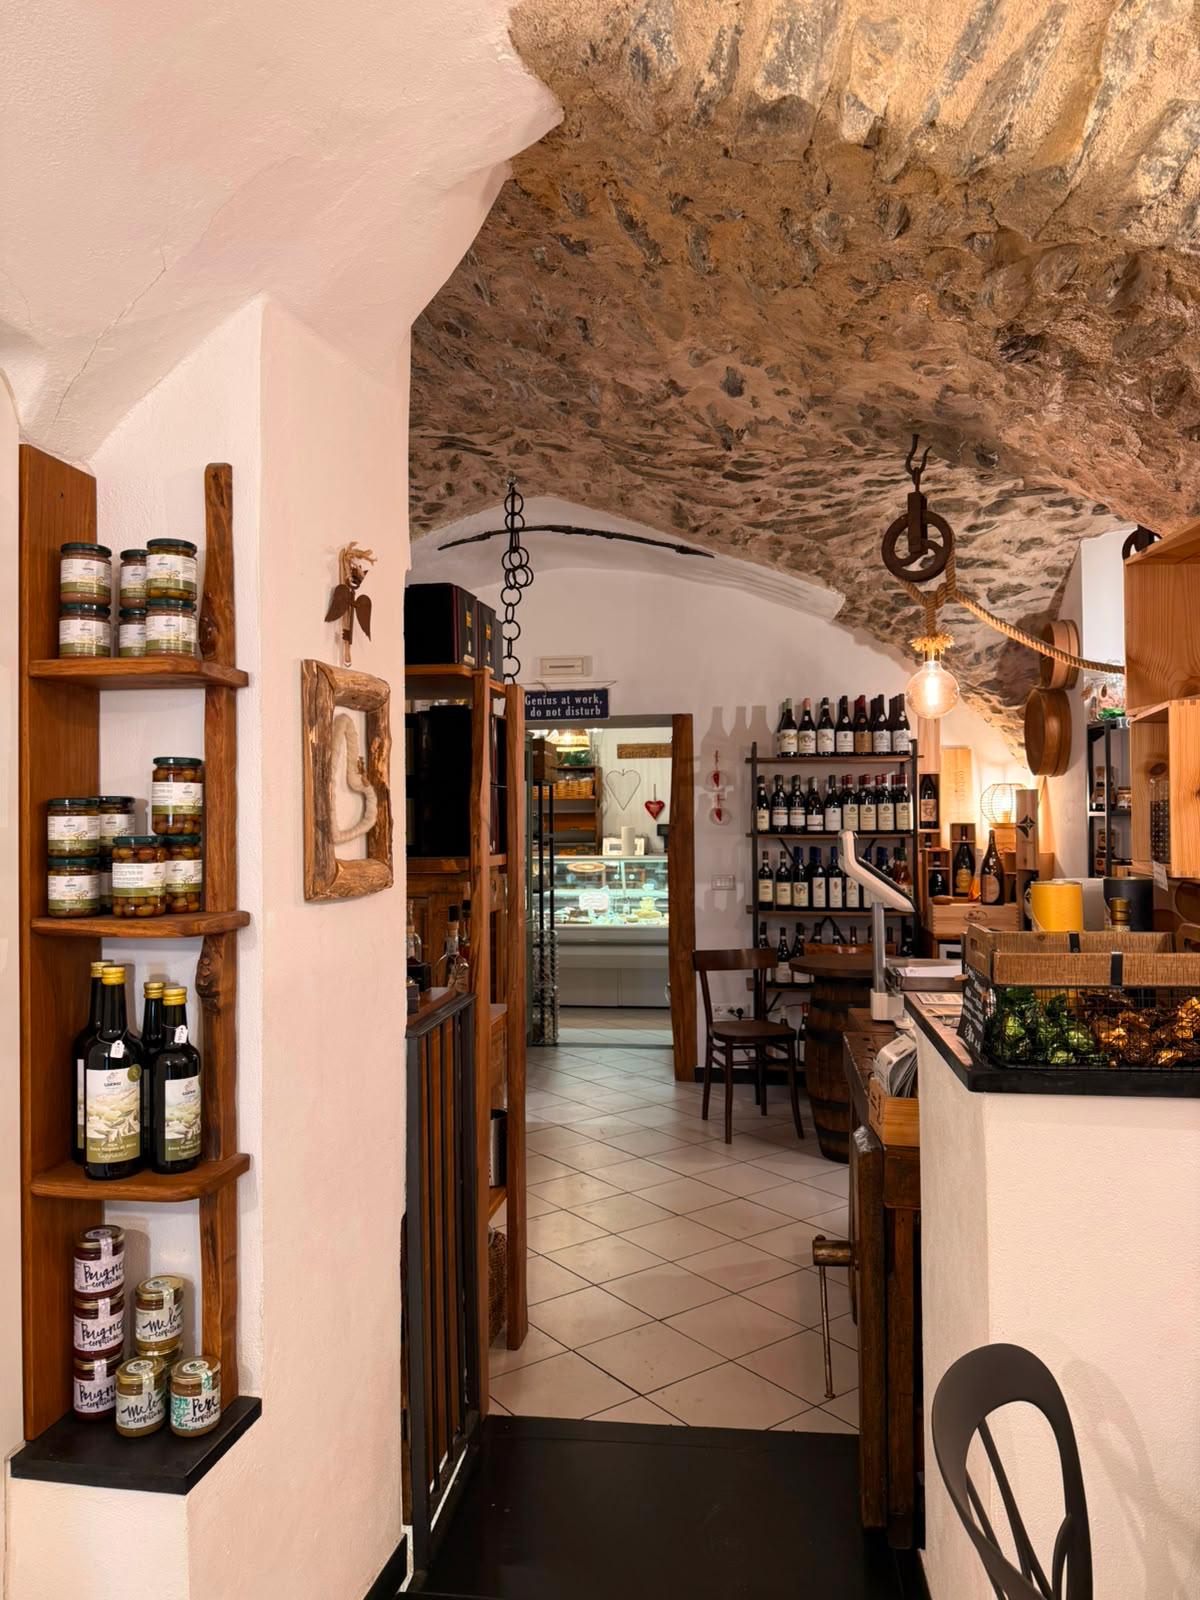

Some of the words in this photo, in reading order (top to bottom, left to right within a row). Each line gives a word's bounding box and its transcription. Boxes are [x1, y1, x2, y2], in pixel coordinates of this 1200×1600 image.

[525, 694, 557, 705] Genius
[561, 695, 570, 704] at
[575, 693, 603, 705] work,
[530, 706, 541, 717] do
[546, 707, 561, 717] not
[565, 705, 601, 716] disturb
[142, 1307, 182, 1333] Mele
[121, 1391, 164, 1418] Mele
[192, 1396, 219, 1417] Pere
